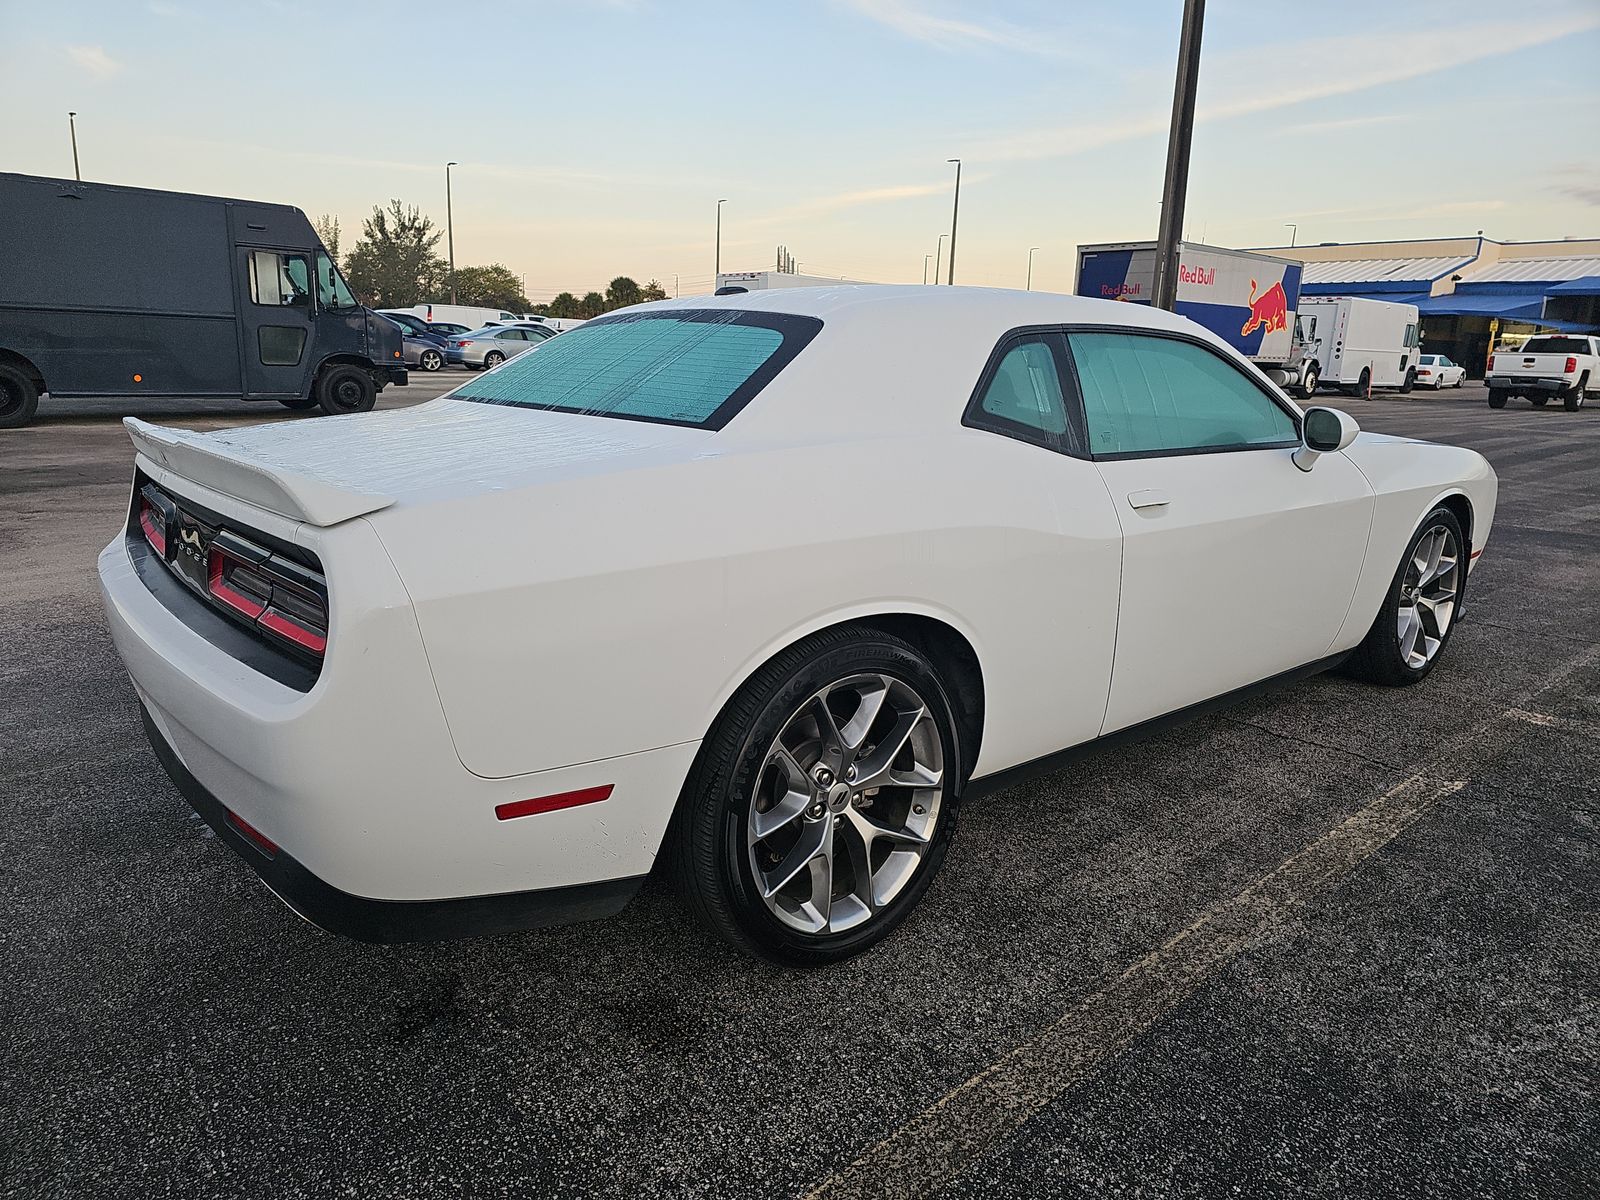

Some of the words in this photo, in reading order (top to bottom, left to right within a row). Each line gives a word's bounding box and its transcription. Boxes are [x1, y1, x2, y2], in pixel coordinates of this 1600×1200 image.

[1179, 264, 1198, 283] Red
[1198, 267, 1215, 285] Bull
[1101, 284, 1120, 295] Red
[1121, 283, 1140, 295] Bull
